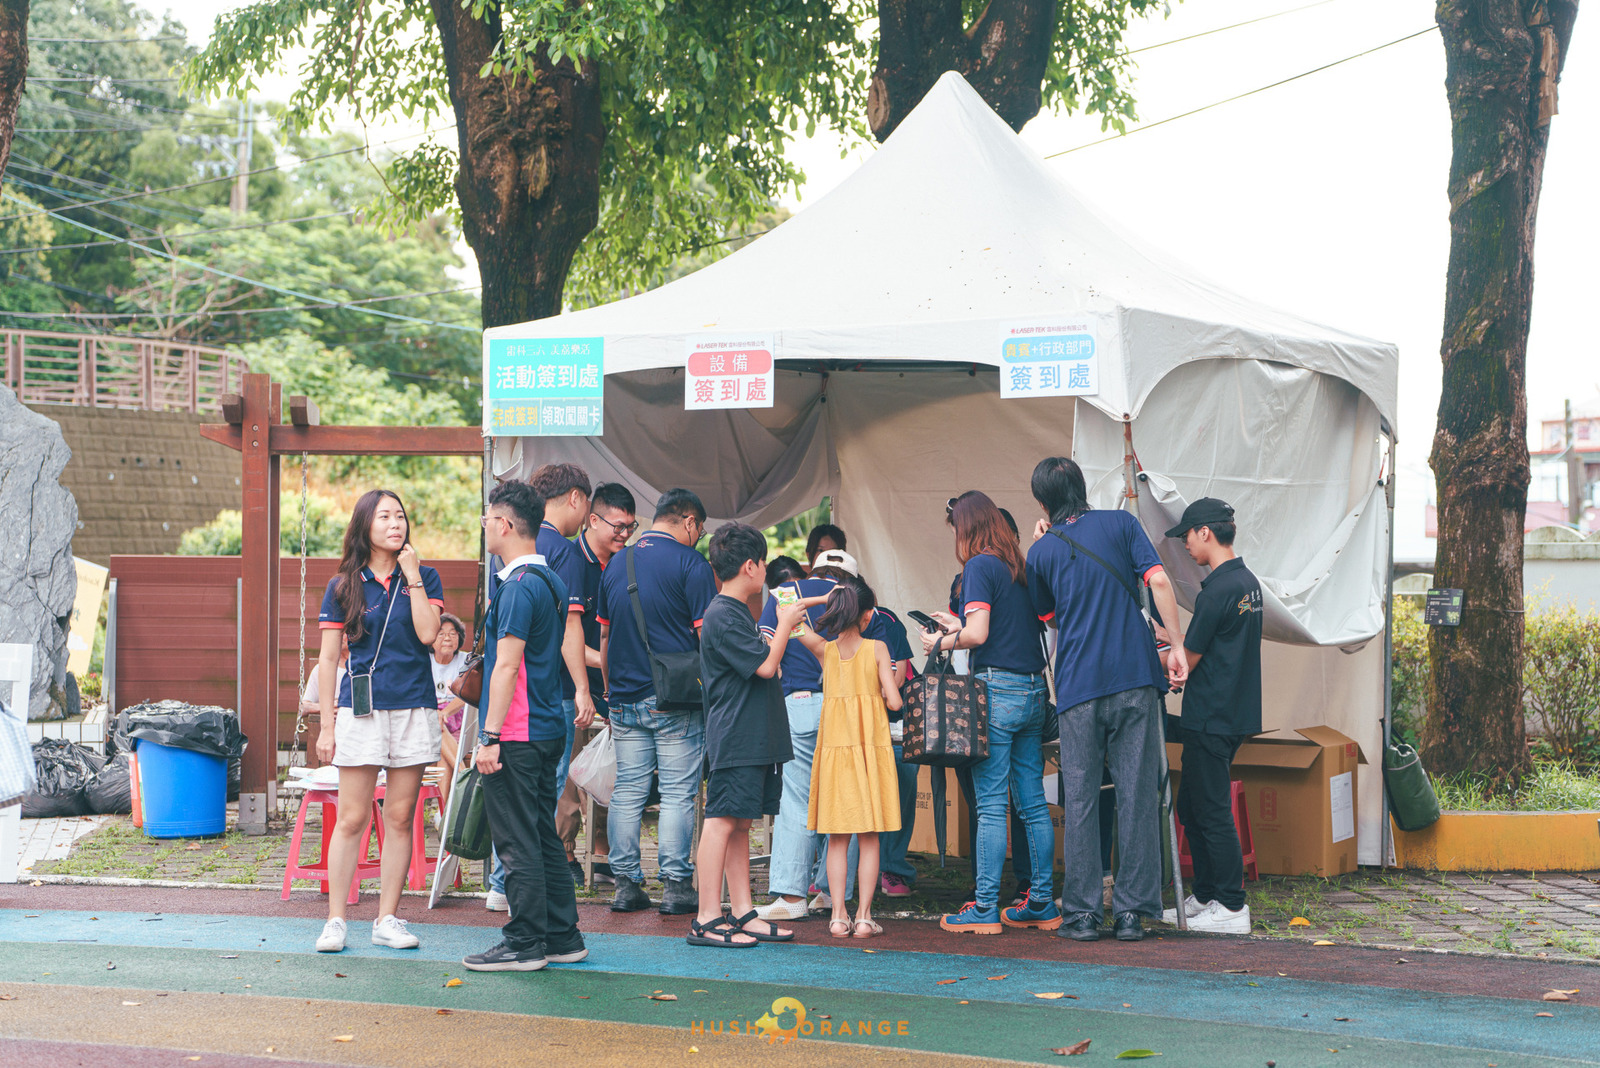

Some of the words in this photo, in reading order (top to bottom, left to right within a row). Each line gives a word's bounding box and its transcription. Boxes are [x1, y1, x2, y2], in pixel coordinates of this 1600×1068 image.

[496, 363, 599, 389] 活動簽到處
[709, 353, 748, 373] 設備
[694, 377, 766, 403] 簽到處
[1010, 363, 1091, 391] 簽到處
